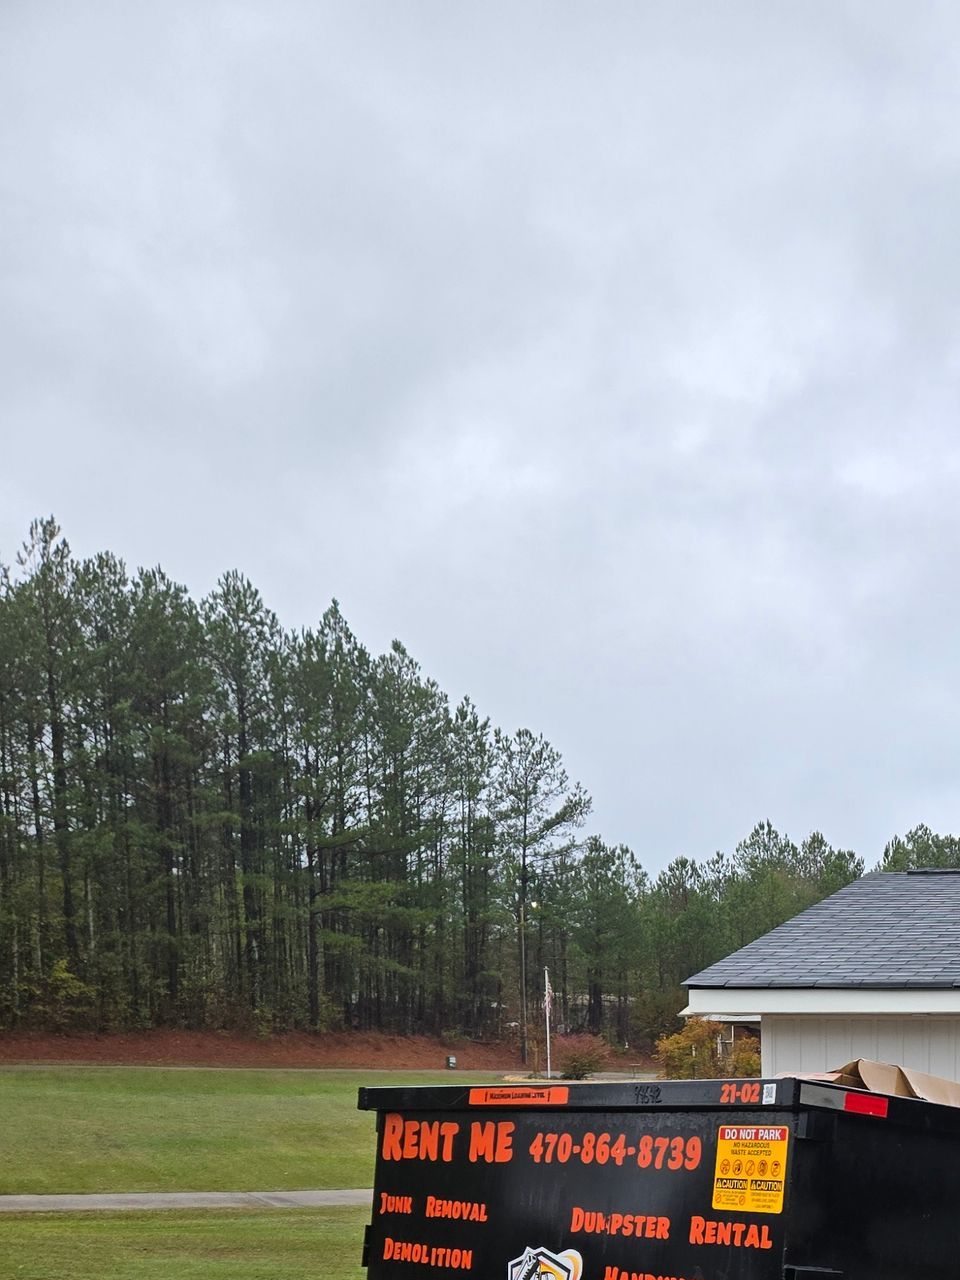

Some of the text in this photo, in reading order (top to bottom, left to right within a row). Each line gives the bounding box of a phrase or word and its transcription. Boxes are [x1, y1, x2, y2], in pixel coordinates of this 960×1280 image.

[719, 1083, 761, 1103] 21-02
[382, 1114, 702, 1171] RENT ME 470-864-8739
[724, 1128, 781, 1140] DO NOT PARK
[721, 1179, 748, 1190] CAUTION
[756, 1181, 782, 1192] CAUTION
[379, 1192, 488, 1222] JUNK REMOVAL
[570, 1206, 773, 1250] DUMPSTER RENTAL
[382, 1237, 473, 1270] DEMOLITION
